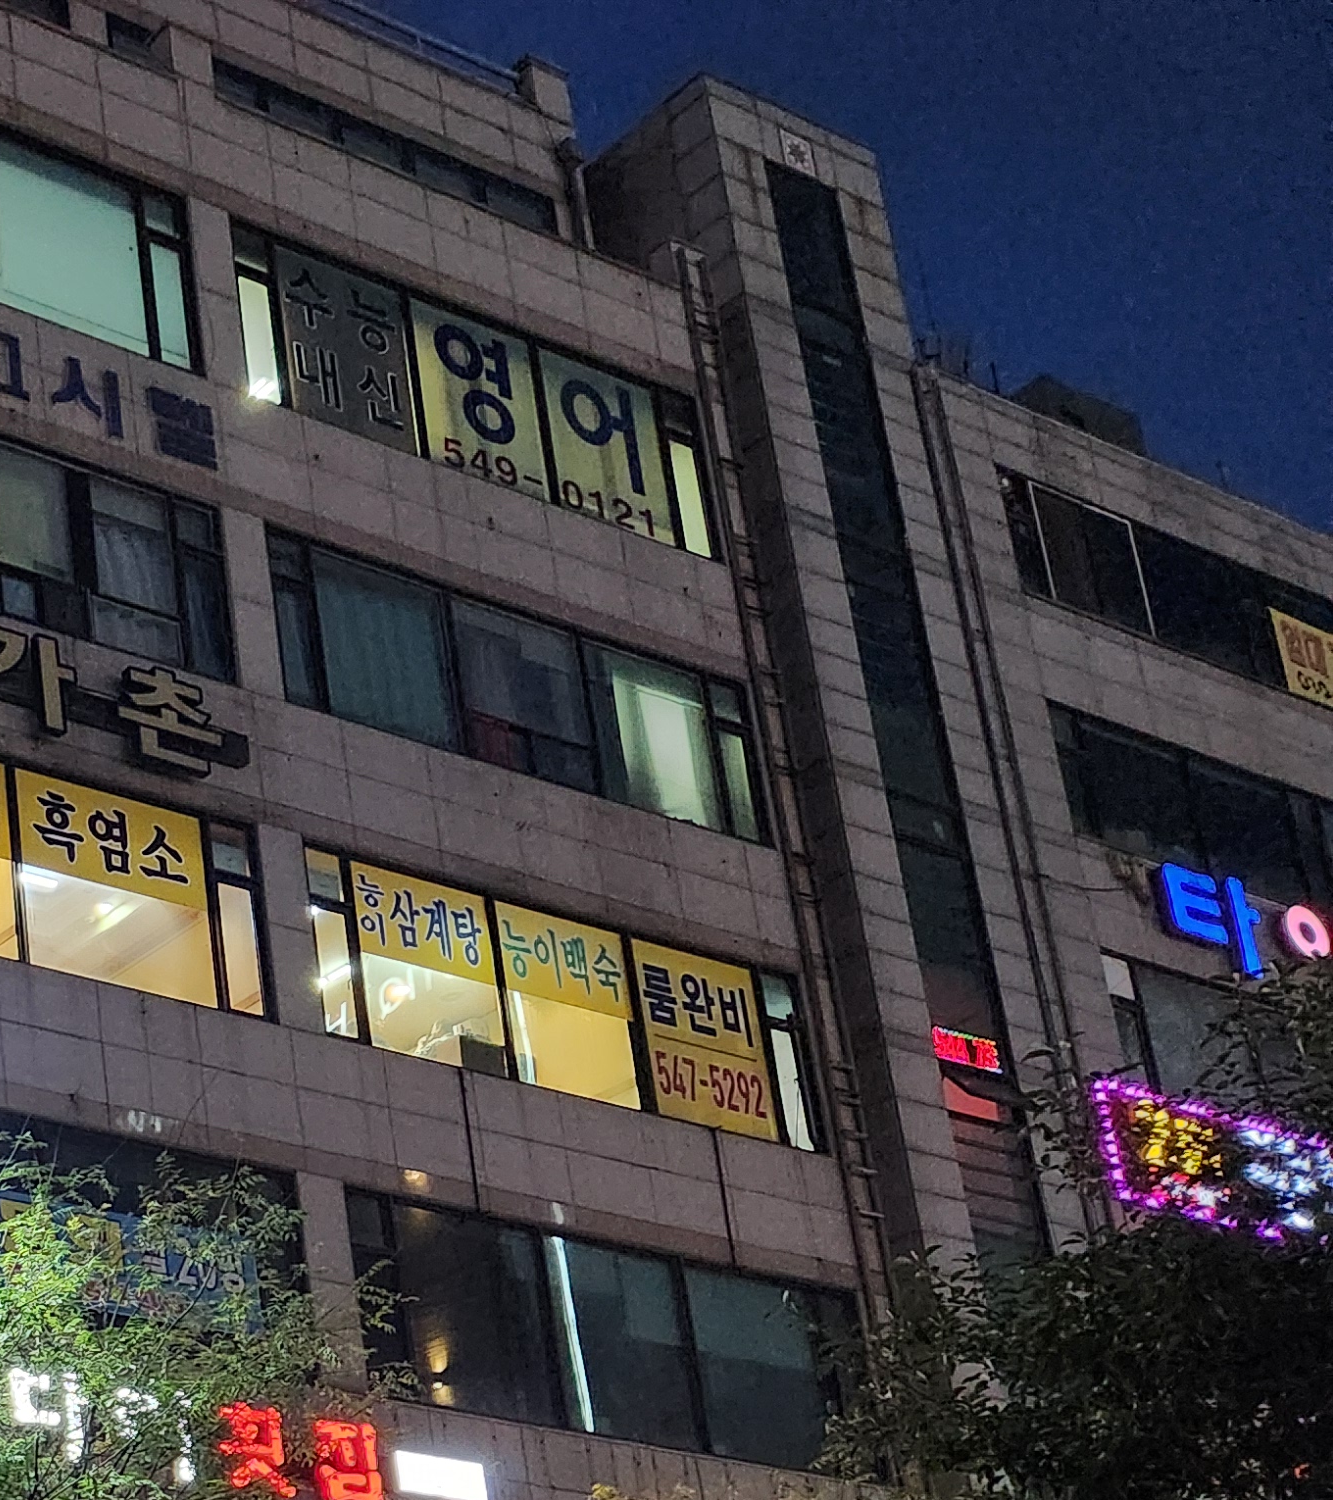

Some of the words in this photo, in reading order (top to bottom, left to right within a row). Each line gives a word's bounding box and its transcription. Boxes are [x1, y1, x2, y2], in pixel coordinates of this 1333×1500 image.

[284, 268, 396, 355] 수능
[293, 341, 404, 430] 내신
[434, 322, 645, 497] 영어
[443, 437, 656, 538] 549-0121
[33, 790, 189, 885] 흑염소
[502, 919, 623, 1002] 능이백숙
[642, 963, 755, 1048] 룸완비
[655, 1050, 768, 1120] 547-5292
